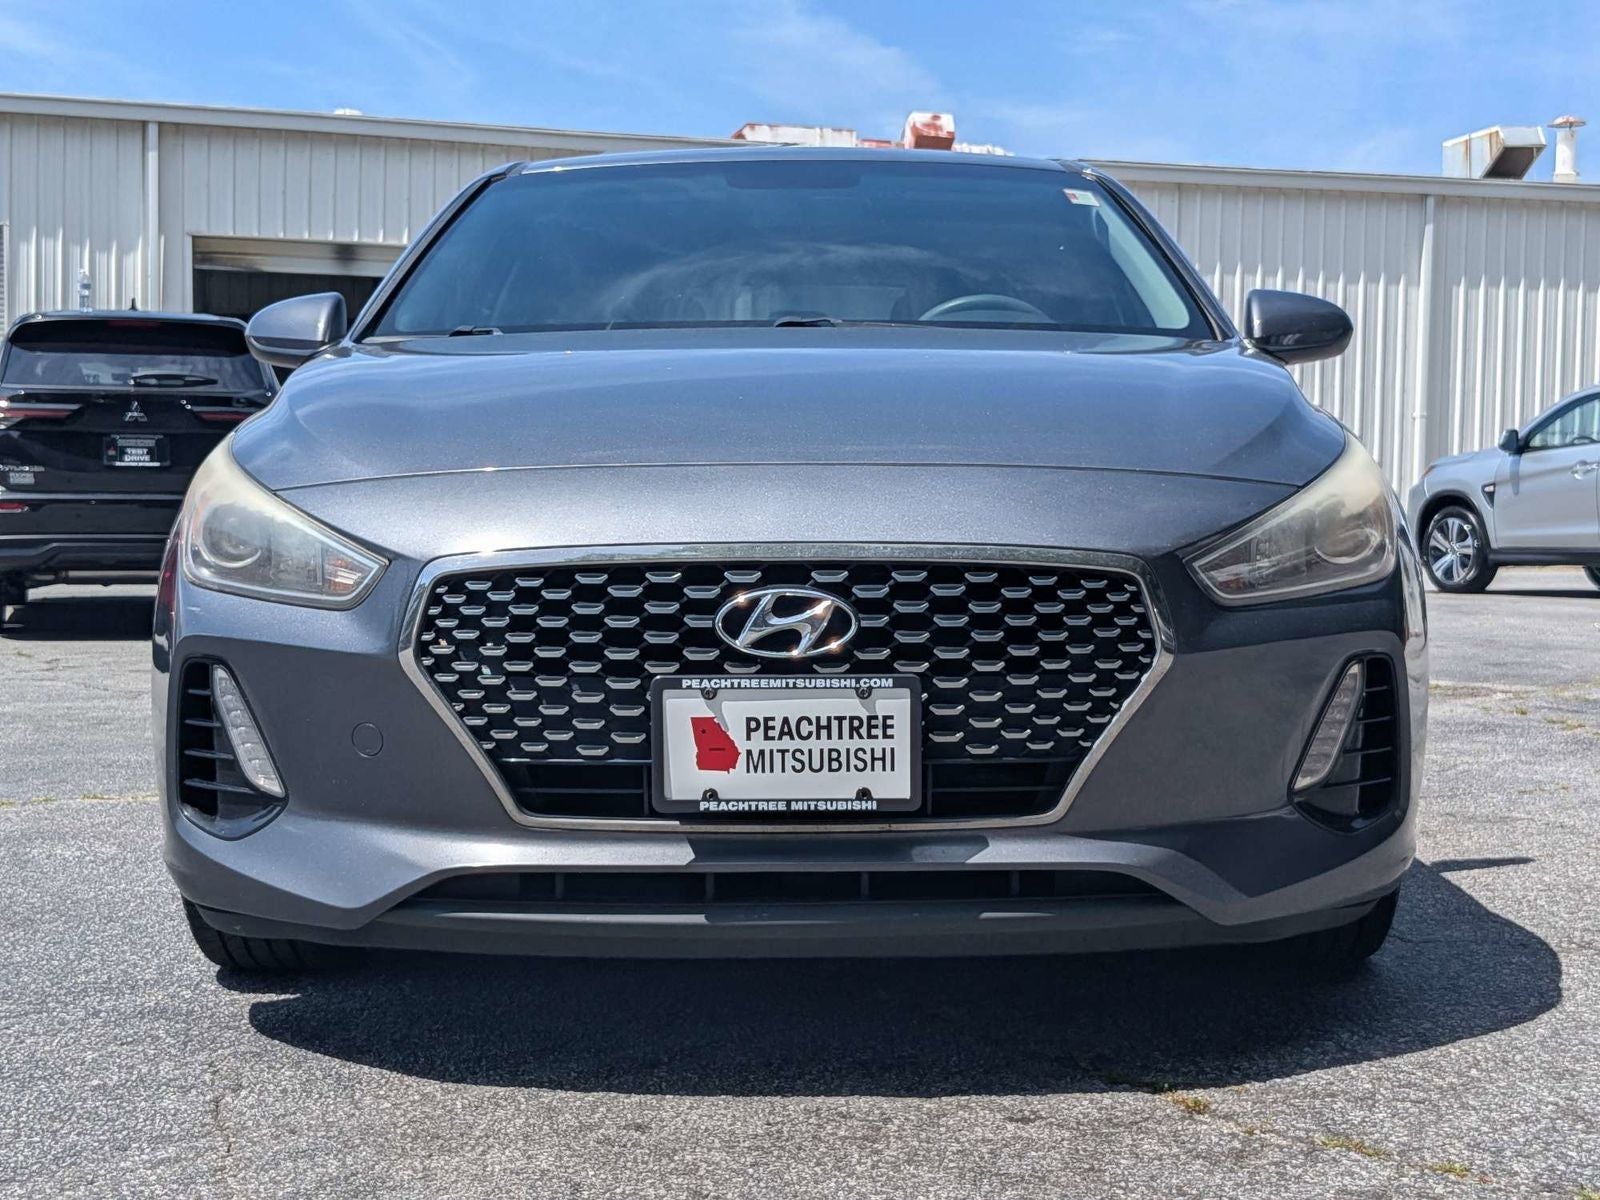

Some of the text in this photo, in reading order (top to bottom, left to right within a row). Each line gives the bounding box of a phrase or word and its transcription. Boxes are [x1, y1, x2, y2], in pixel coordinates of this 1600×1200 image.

[682, 677, 893, 688] PEACHTREEMITSUBISHI.COM
[745, 715, 895, 741] PEACHTREE
[745, 747, 896, 773] MITSUBISHI
[699, 800, 877, 811] PEACHTREE MITSUBISHI
